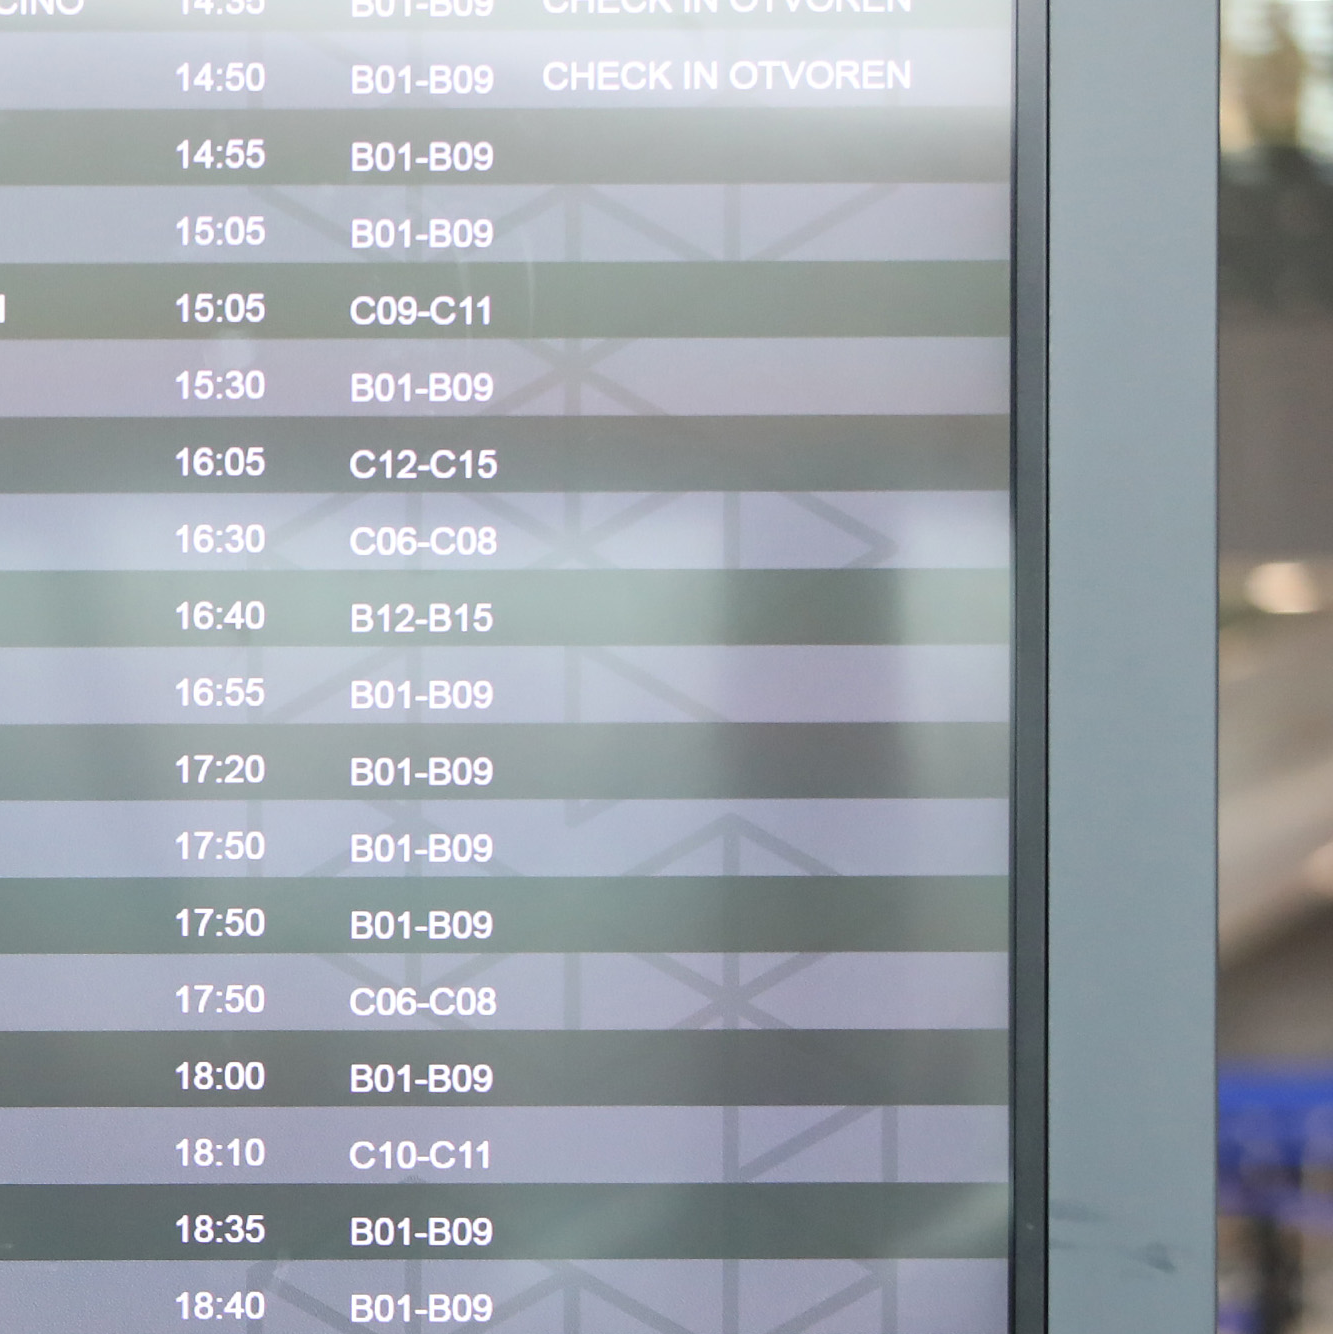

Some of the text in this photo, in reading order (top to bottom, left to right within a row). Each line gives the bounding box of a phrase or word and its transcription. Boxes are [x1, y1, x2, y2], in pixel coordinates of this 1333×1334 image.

[176, 62, 266, 92] 14:50
[351, 64, 494, 94] B01-B09
[542, 60, 673, 91] CHECK
[683, 60, 718, 90] IN
[729, 59, 911, 90] OTVOREN
[176, 138, 266, 169] 14:55
[351, 141, 494, 172] B01-B09
[176, 215, 266, 246] 15:05
[351, 218, 494, 249] B01-B09
[176, 293, 266, 323] 15:05
[350, 295, 490, 325] C09-C11
[175, 370, 265, 400] 15:30
[351, 372, 494, 402] B01-B09
[175, 446, 266, 477] 16:05
[349, 449, 498, 479] C12-C15
[175, 524, 266, 554] 16:30
[349, 526, 497, 556] C06-C08
[176, 600, 265, 630] 16:40
[351, 602, 494, 633] B12-B15
[175, 677, 265, 707] 16:55
[351, 680, 494, 709] B01-B09
[175, 754, 265, 784] 17:20
[351, 756, 494, 786] B01-B09
[175, 831, 265, 860] 17:50
[351, 833, 493, 863] B01-B09
[175, 984, 265, 1013] 17:50
[349, 986, 497, 1016] C06-C08
[175, 1061, 265, 1090] 18:00
[350, 1063, 493, 1093] B01-B09
[175, 1137, 265, 1167] 18:10
[349, 1140, 489, 1170] C10-C11
[175, 1214, 266, 1243] 18:35
[351, 1217, 493, 1246] B01-B09
[175, 1291, 265, 1320] 18:40
[351, 1293, 493, 1323] B01-B09
